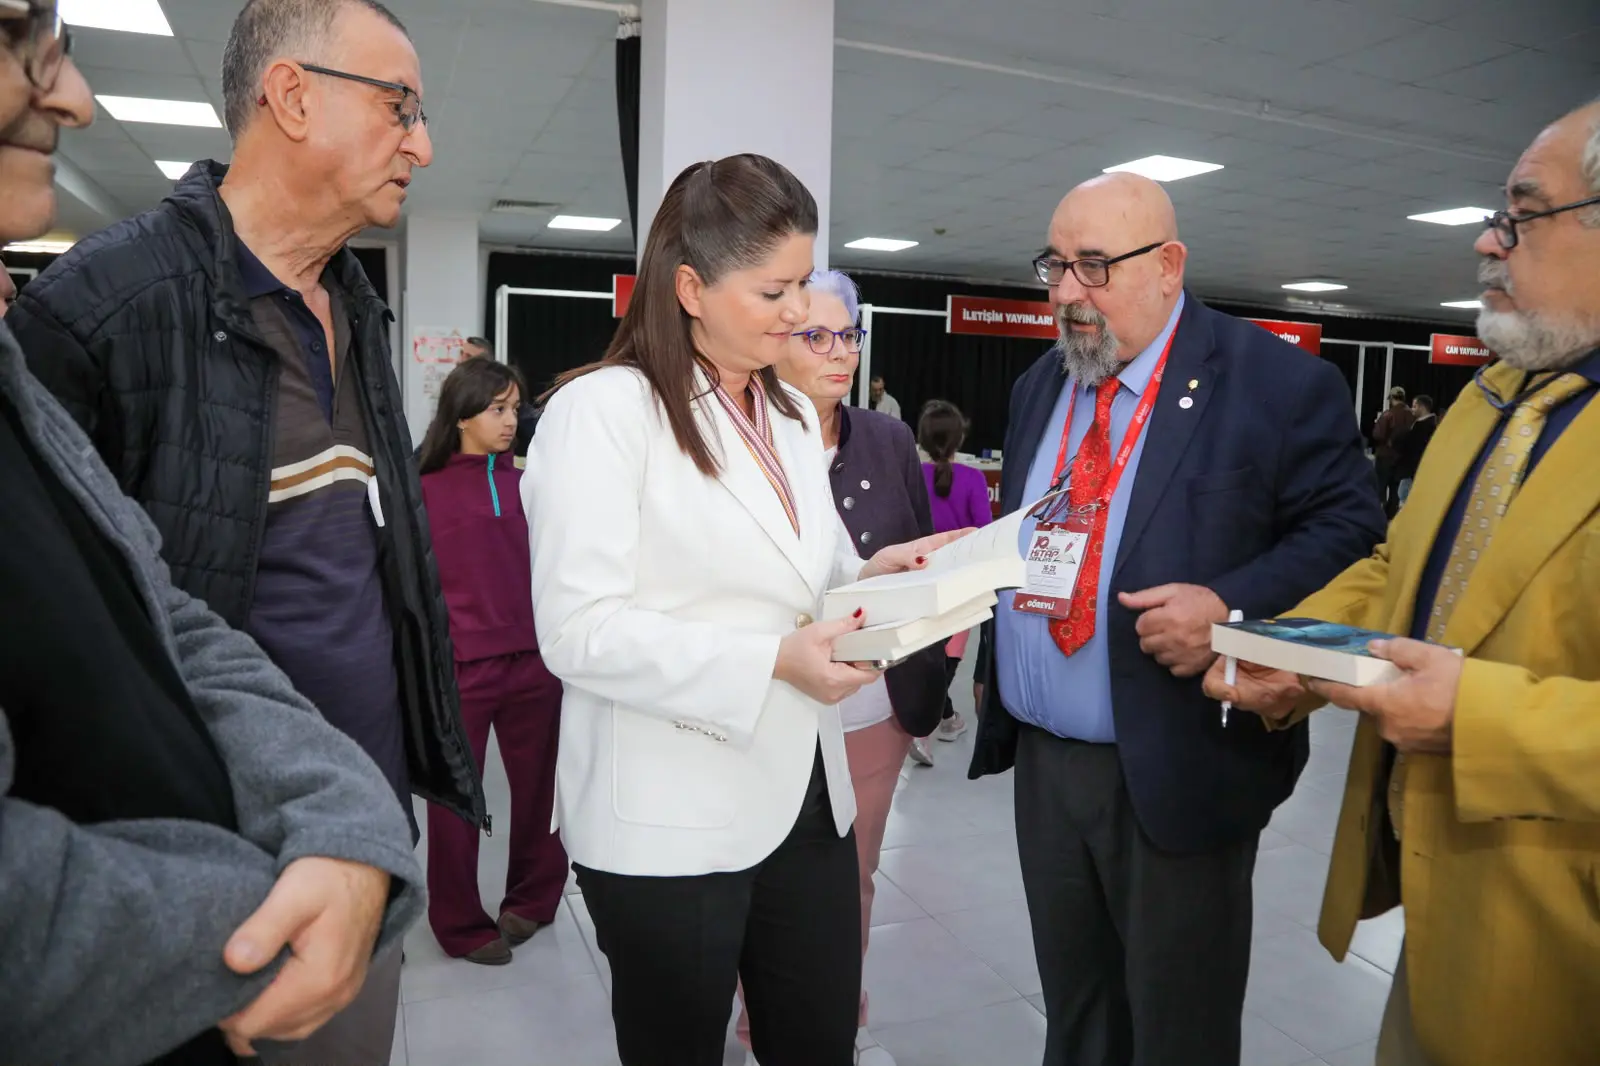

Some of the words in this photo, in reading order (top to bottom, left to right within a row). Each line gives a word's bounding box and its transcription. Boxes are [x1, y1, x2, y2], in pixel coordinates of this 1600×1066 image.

[962, 308, 1003, 324] İLETİŞİM
[1005, 313, 1053, 325] YAYINLARI
[1445, 345, 1458, 355] CAN
[1459, 346, 1490, 357] YAYINLARI
[1026, 599, 1055, 610] GÖREVLİ
